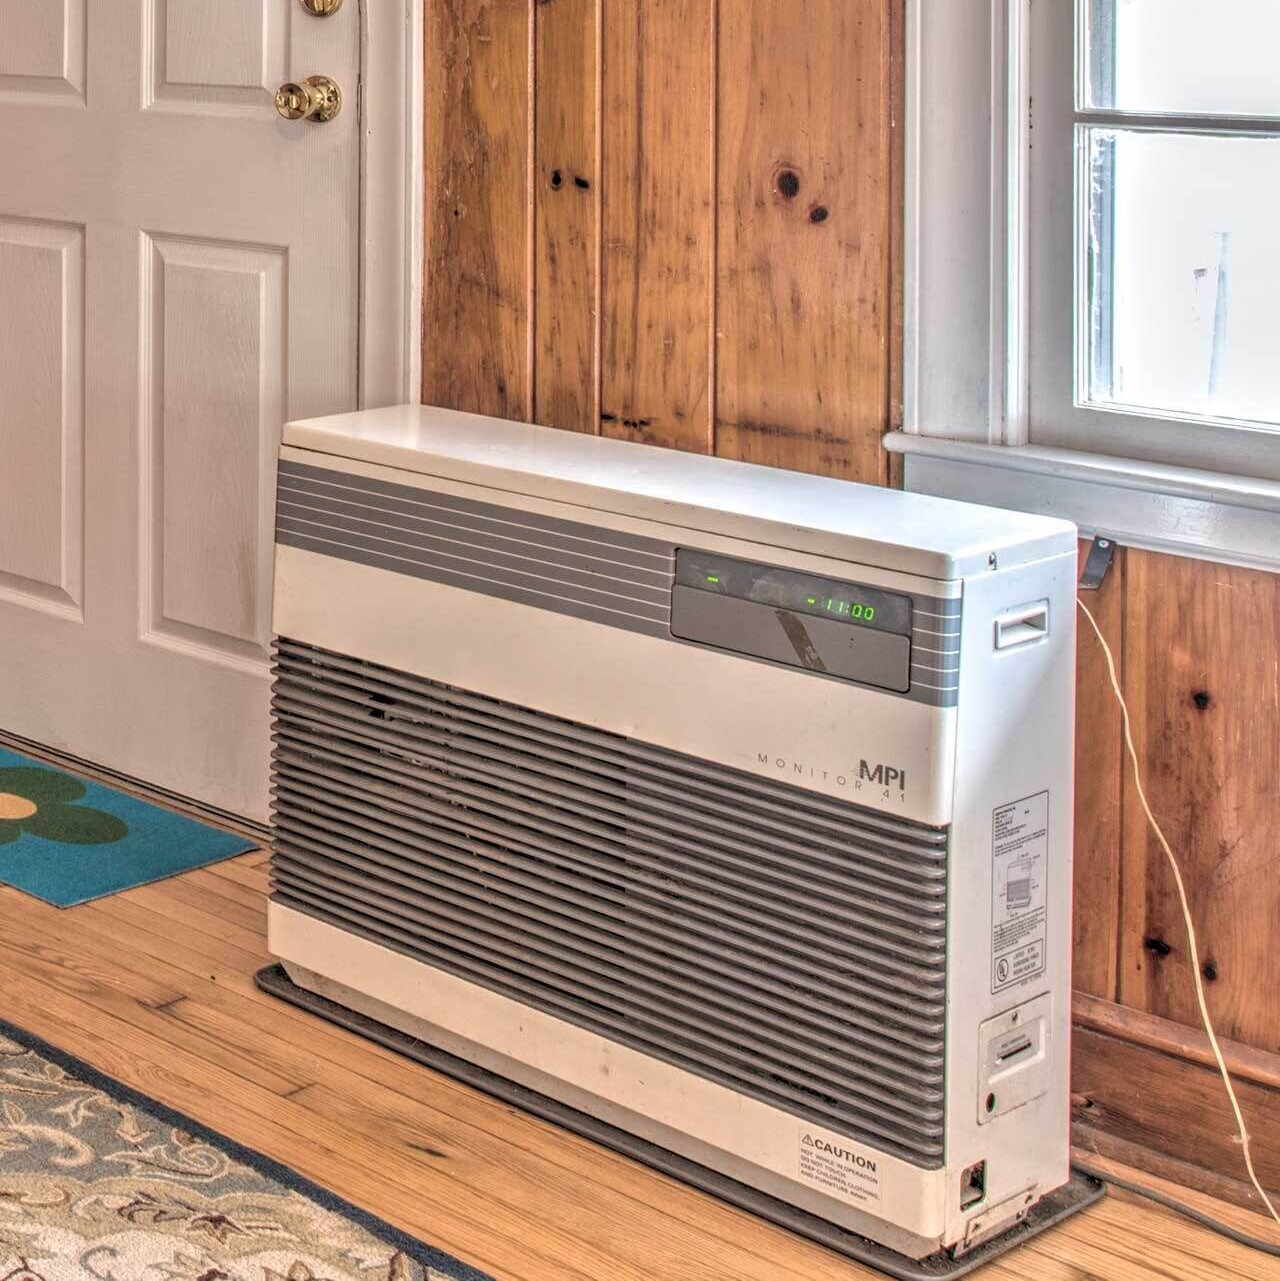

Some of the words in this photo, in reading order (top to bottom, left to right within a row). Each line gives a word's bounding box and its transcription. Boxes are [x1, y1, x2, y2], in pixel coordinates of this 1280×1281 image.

[825, 598, 874, 621] 11:00
[757, 753, 863, 790] MONITOR
[859, 759, 905, 791] MPI
[814, 1139, 877, 1172] CAUTION
